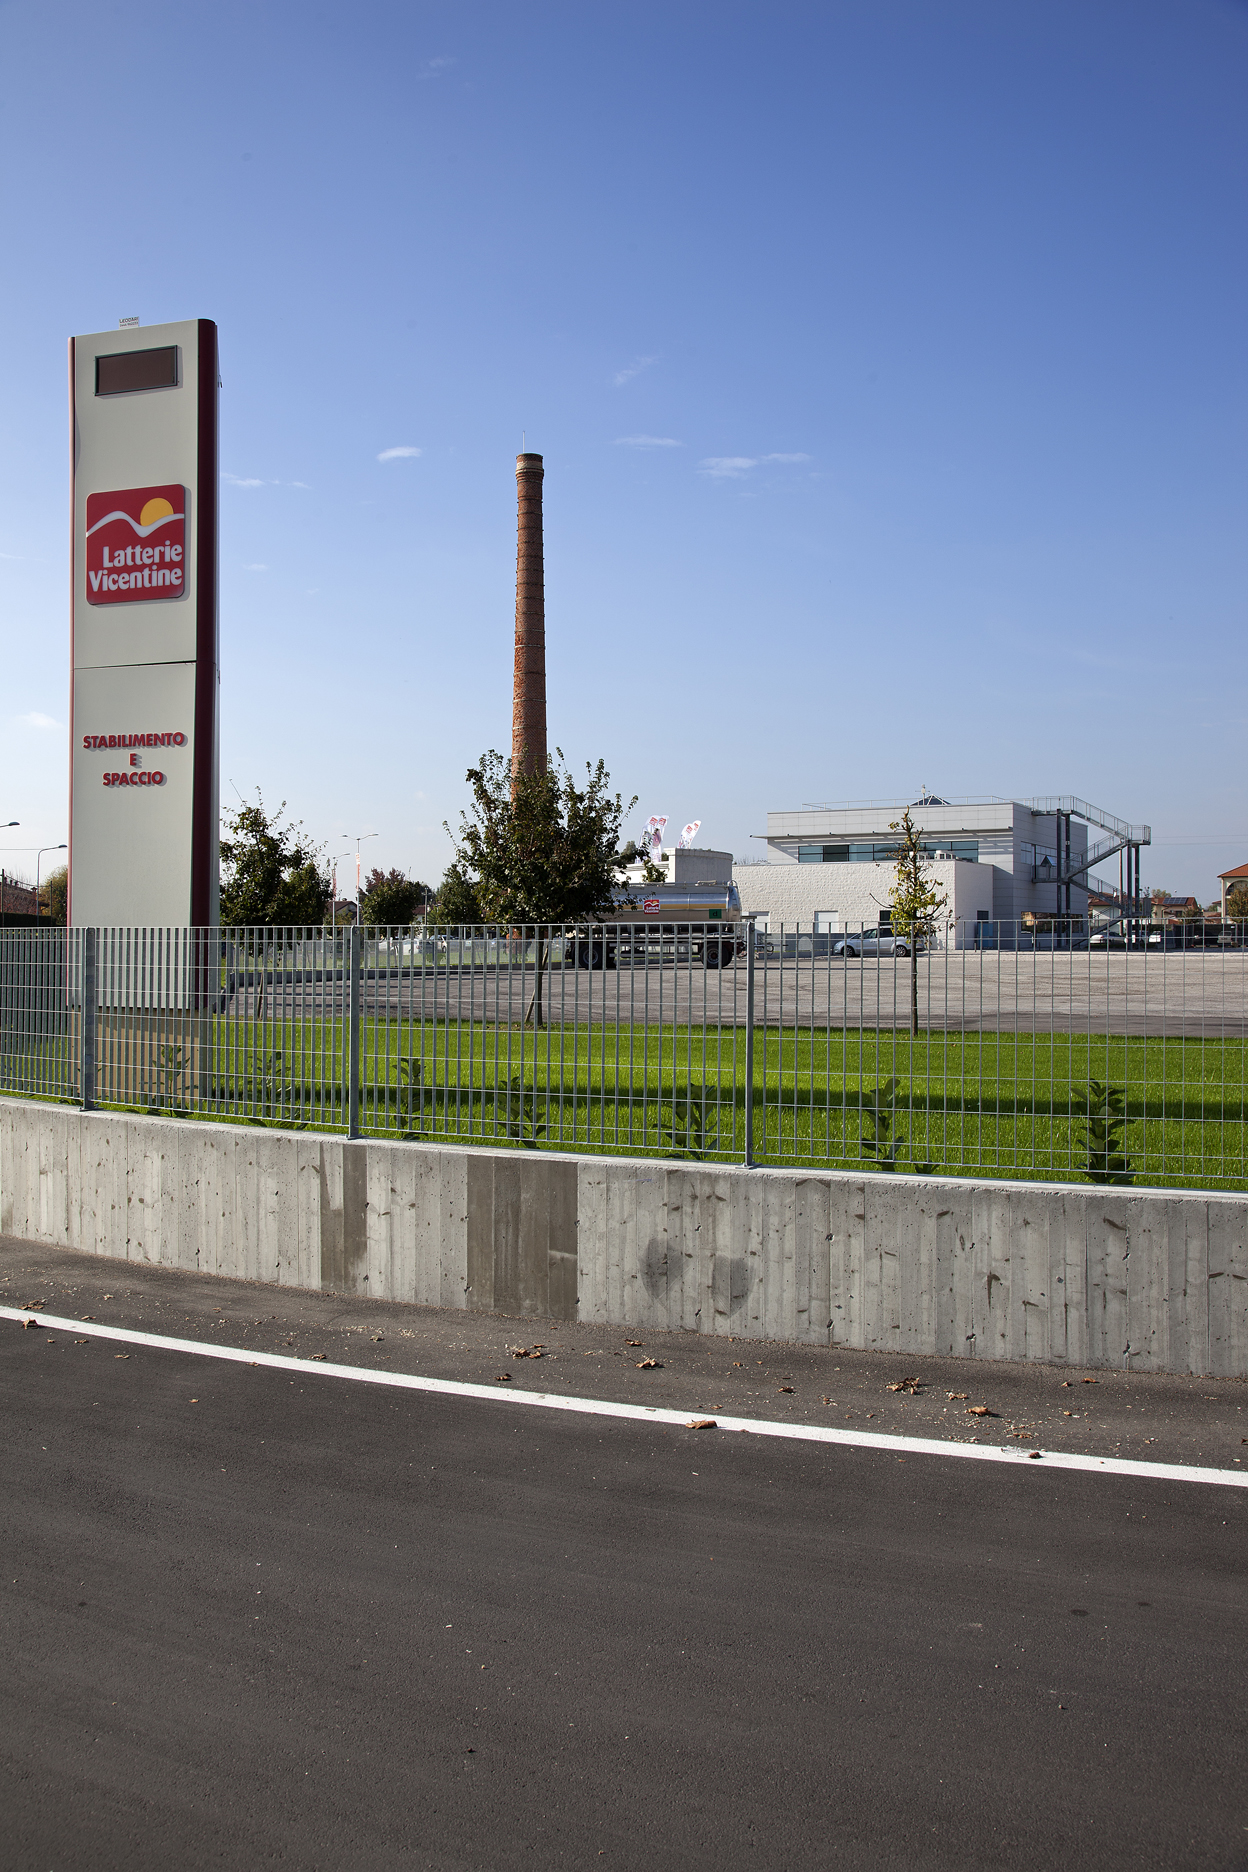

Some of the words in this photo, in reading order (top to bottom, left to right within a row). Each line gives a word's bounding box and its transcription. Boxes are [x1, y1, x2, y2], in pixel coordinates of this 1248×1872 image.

[103, 540, 183, 568] Latterie
[88, 565, 183, 592] Vicentine
[82, 732, 184, 748] STABILIMENTO
[129, 753, 137, 766] E
[102, 771, 164, 786] SPACCIO
